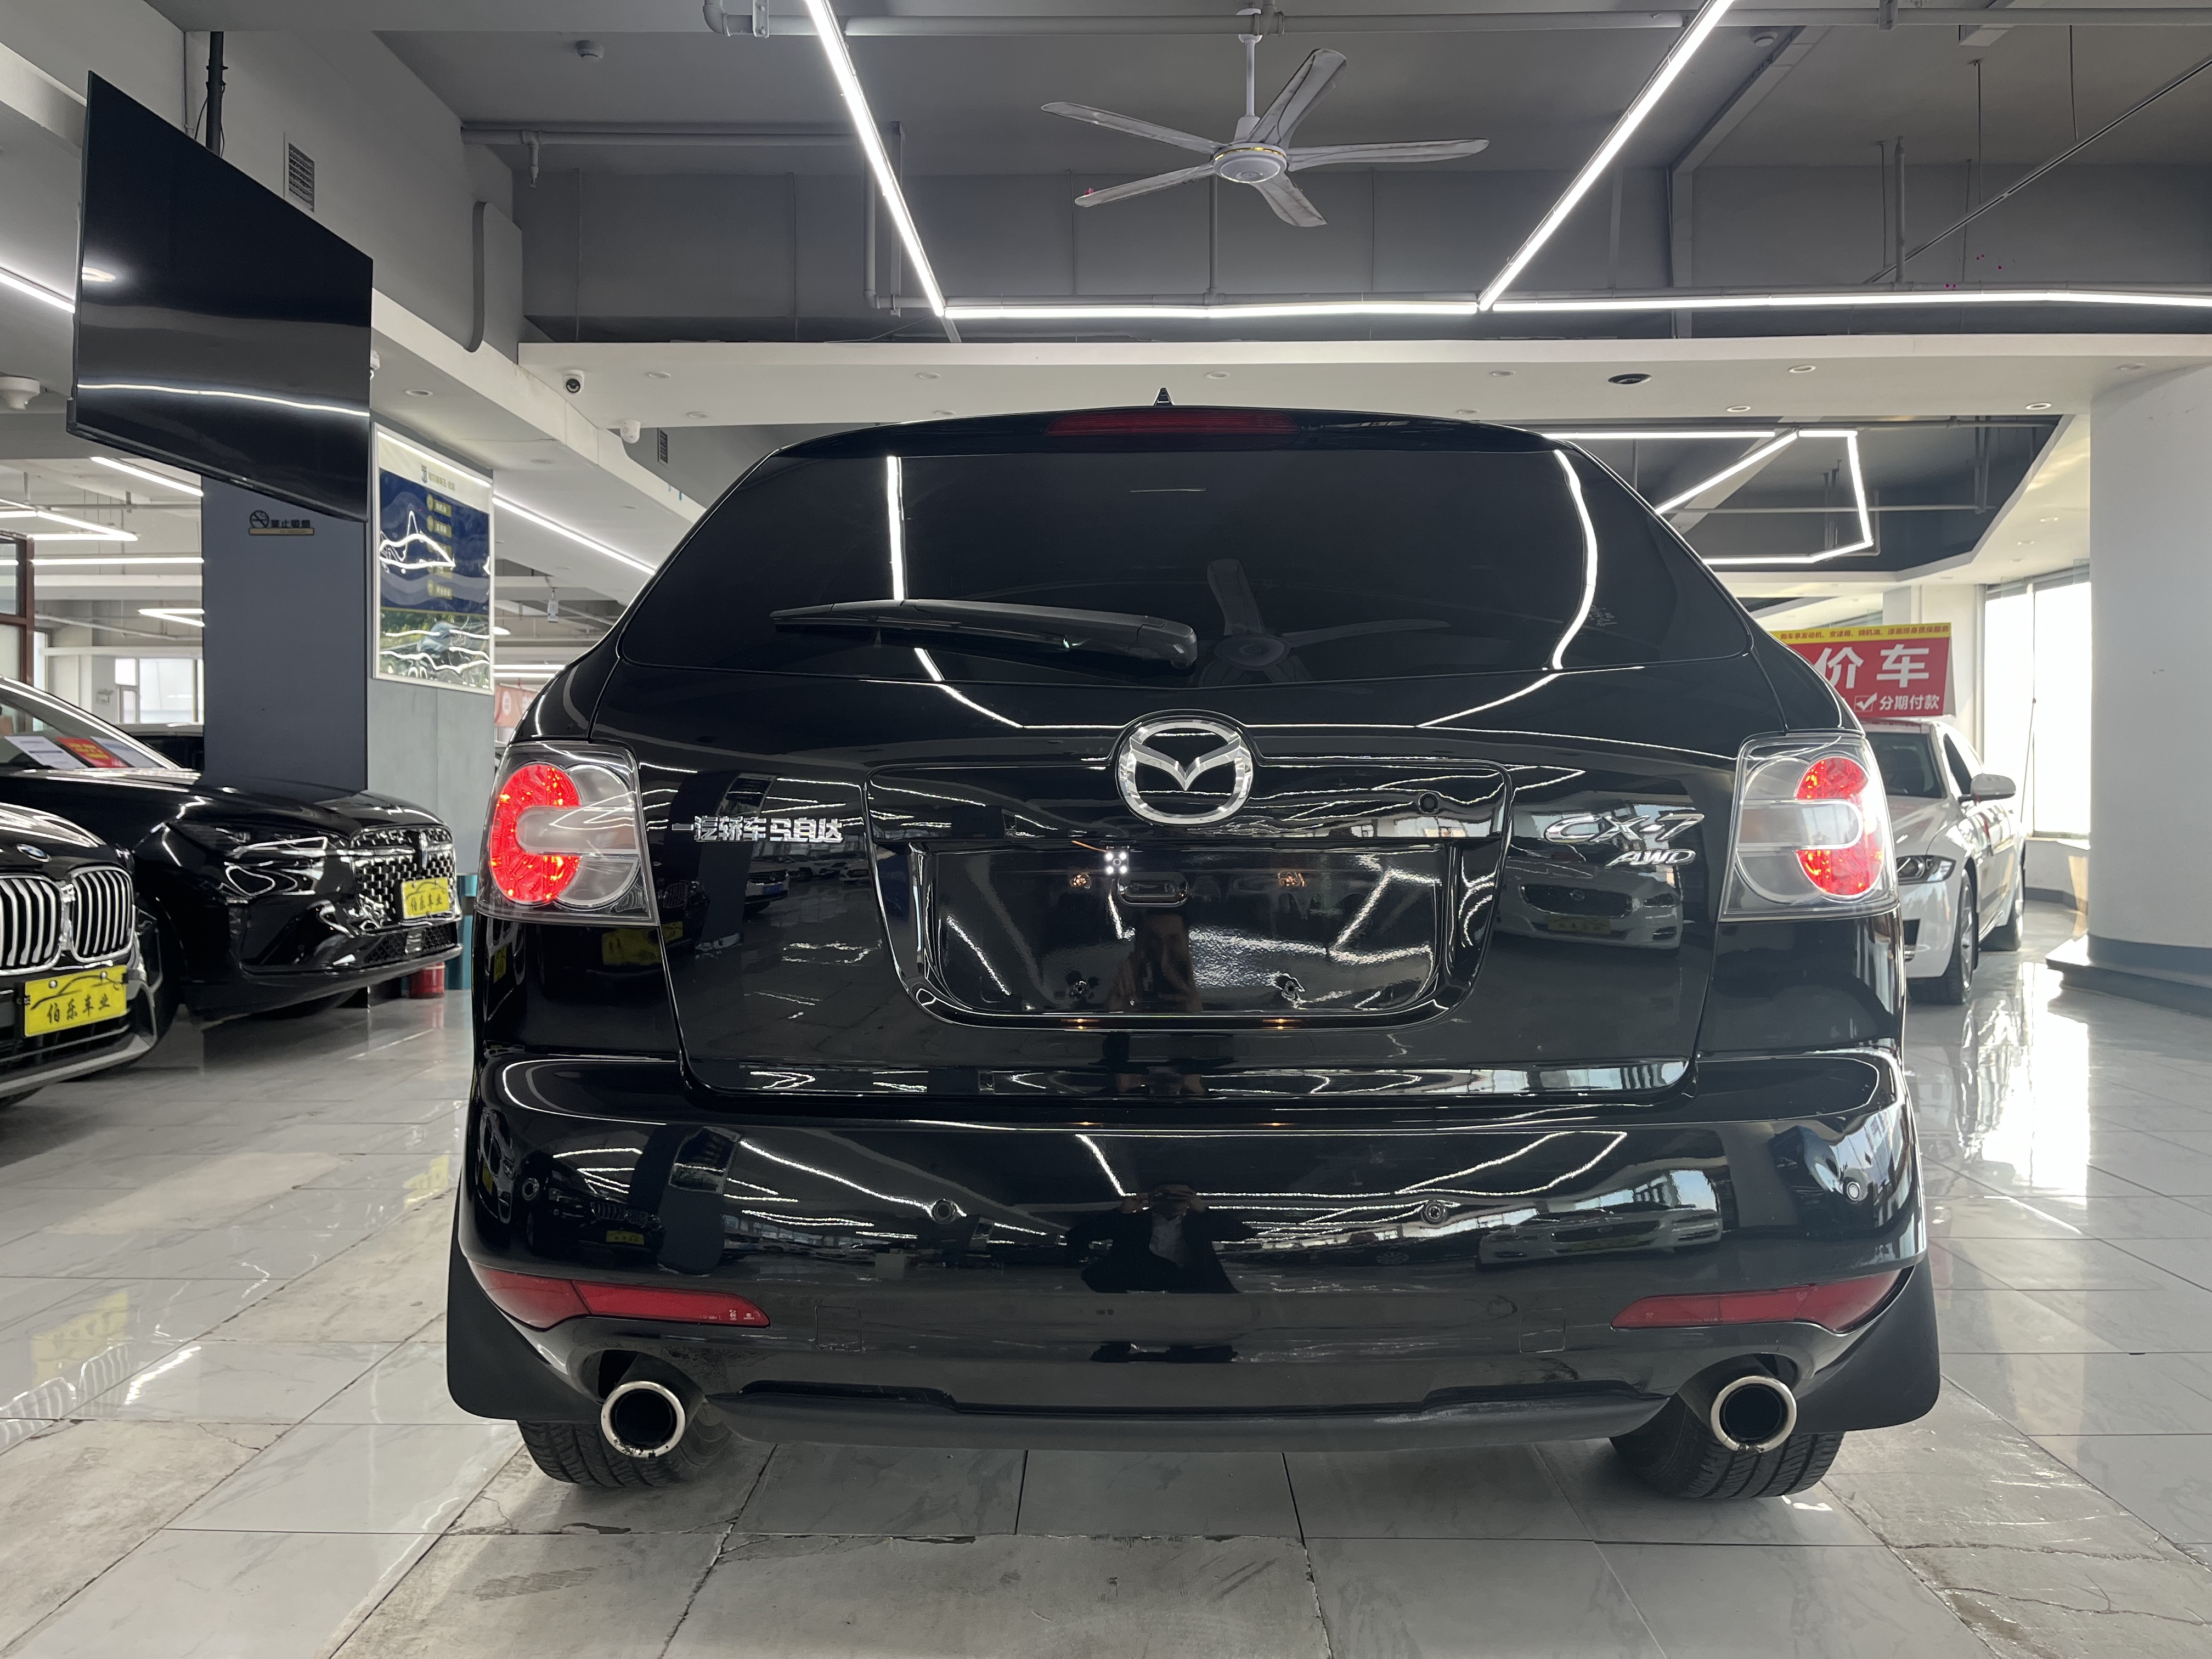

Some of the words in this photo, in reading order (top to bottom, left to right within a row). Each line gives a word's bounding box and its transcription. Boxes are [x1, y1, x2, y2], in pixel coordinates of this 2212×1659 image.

[1879, 694, 1940, 711] 分期付款
[1544, 813, 1705, 843] CX-7
[1605, 849, 1696, 867] AWD
